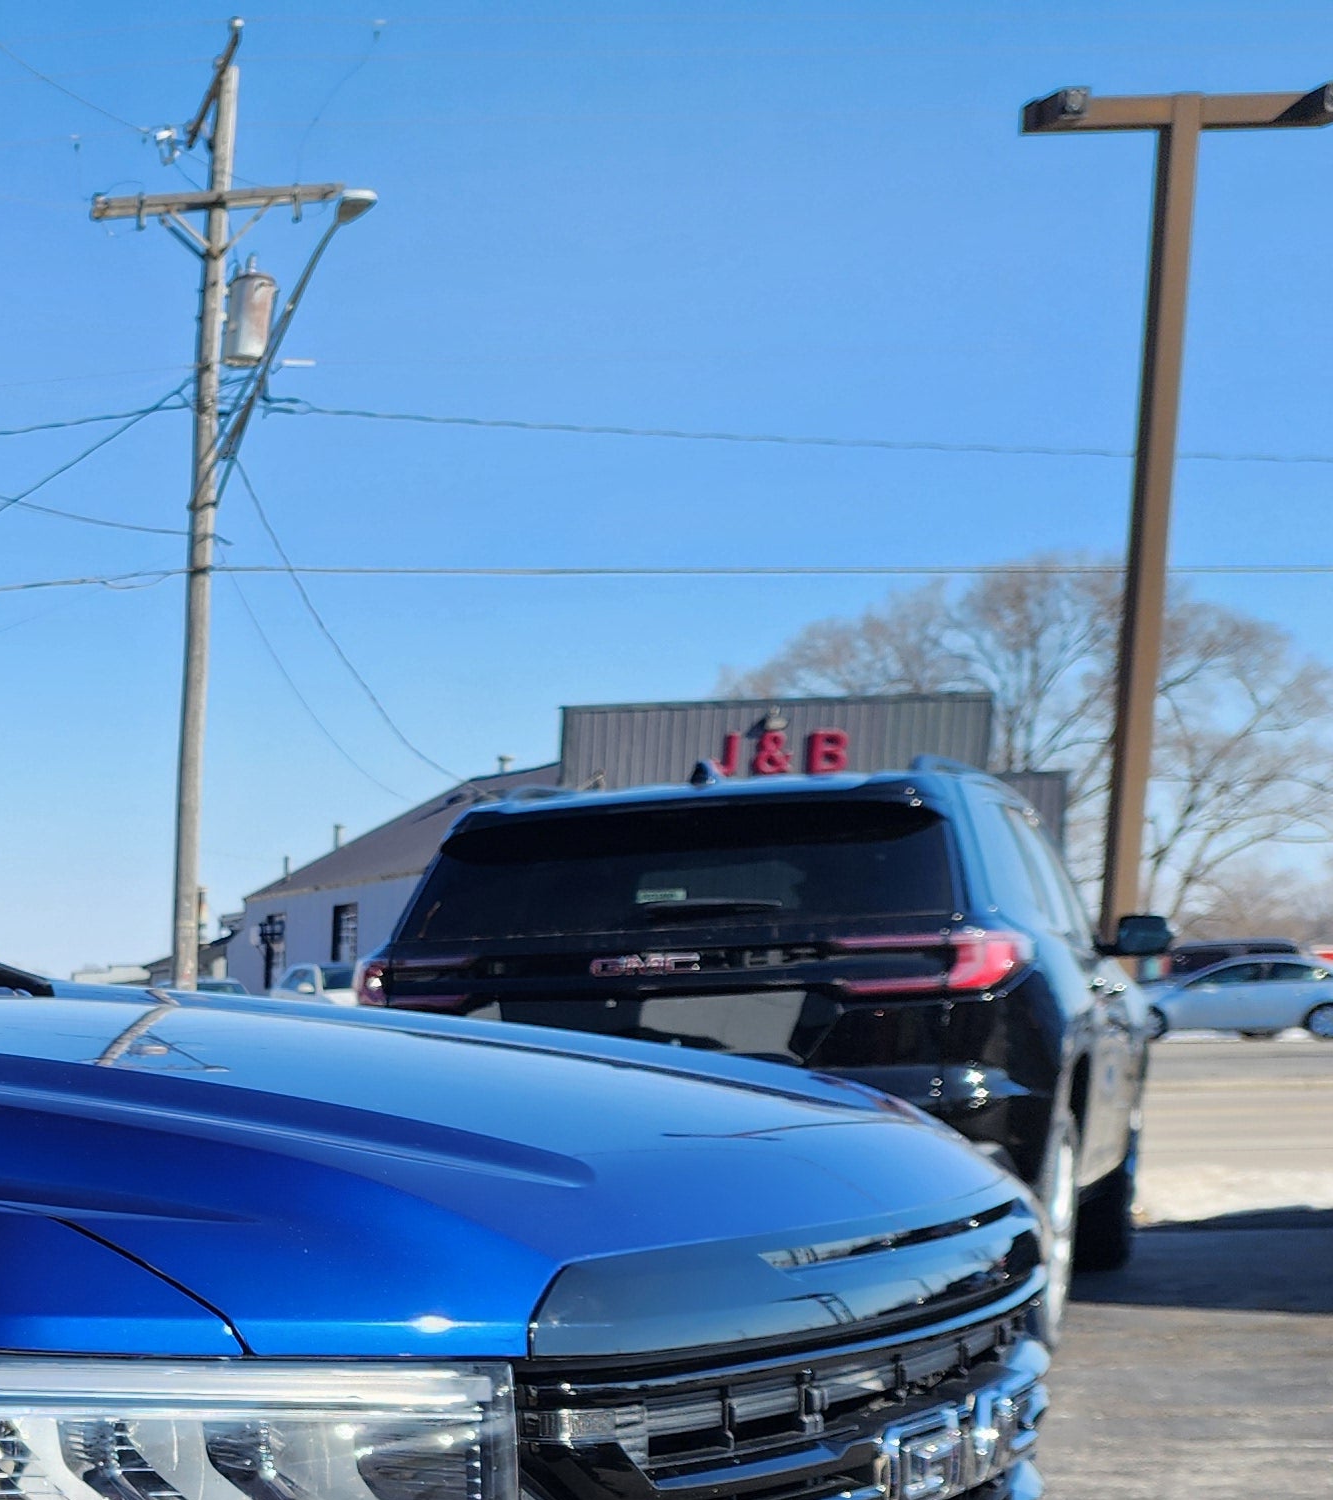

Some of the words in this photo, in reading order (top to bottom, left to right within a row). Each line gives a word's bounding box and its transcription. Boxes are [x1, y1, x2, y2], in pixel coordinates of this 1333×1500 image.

[712, 732, 741, 777] J
[753, 731, 793, 775] &
[807, 728, 849, 774] B
[589, 951, 701, 978] GMC
